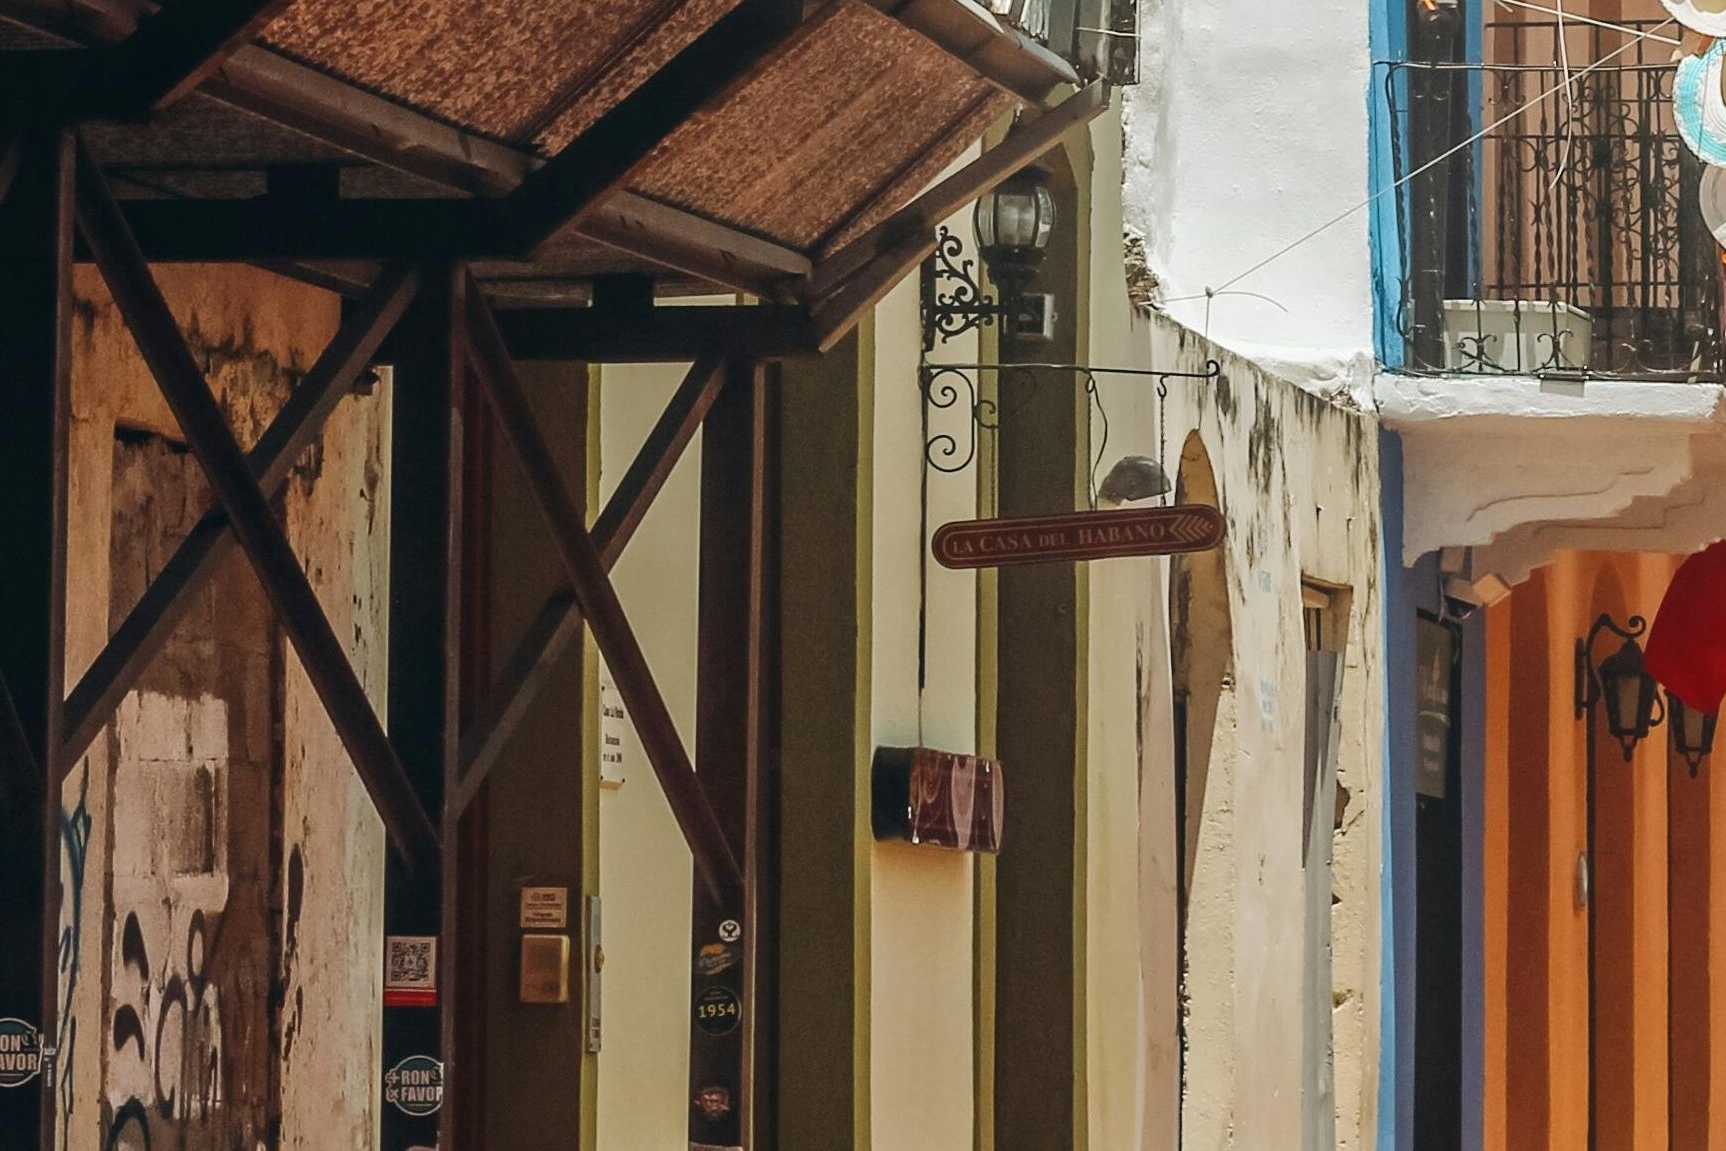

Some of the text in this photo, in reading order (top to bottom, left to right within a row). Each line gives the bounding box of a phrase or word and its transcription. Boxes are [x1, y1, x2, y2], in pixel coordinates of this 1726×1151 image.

[952, 522, 1165, 555] LA CASA DEL HABANO
[698, 1003, 736, 1018] 1954
[0, 1034, 20, 1052] ON
[401, 1070, 430, 1085] RON
